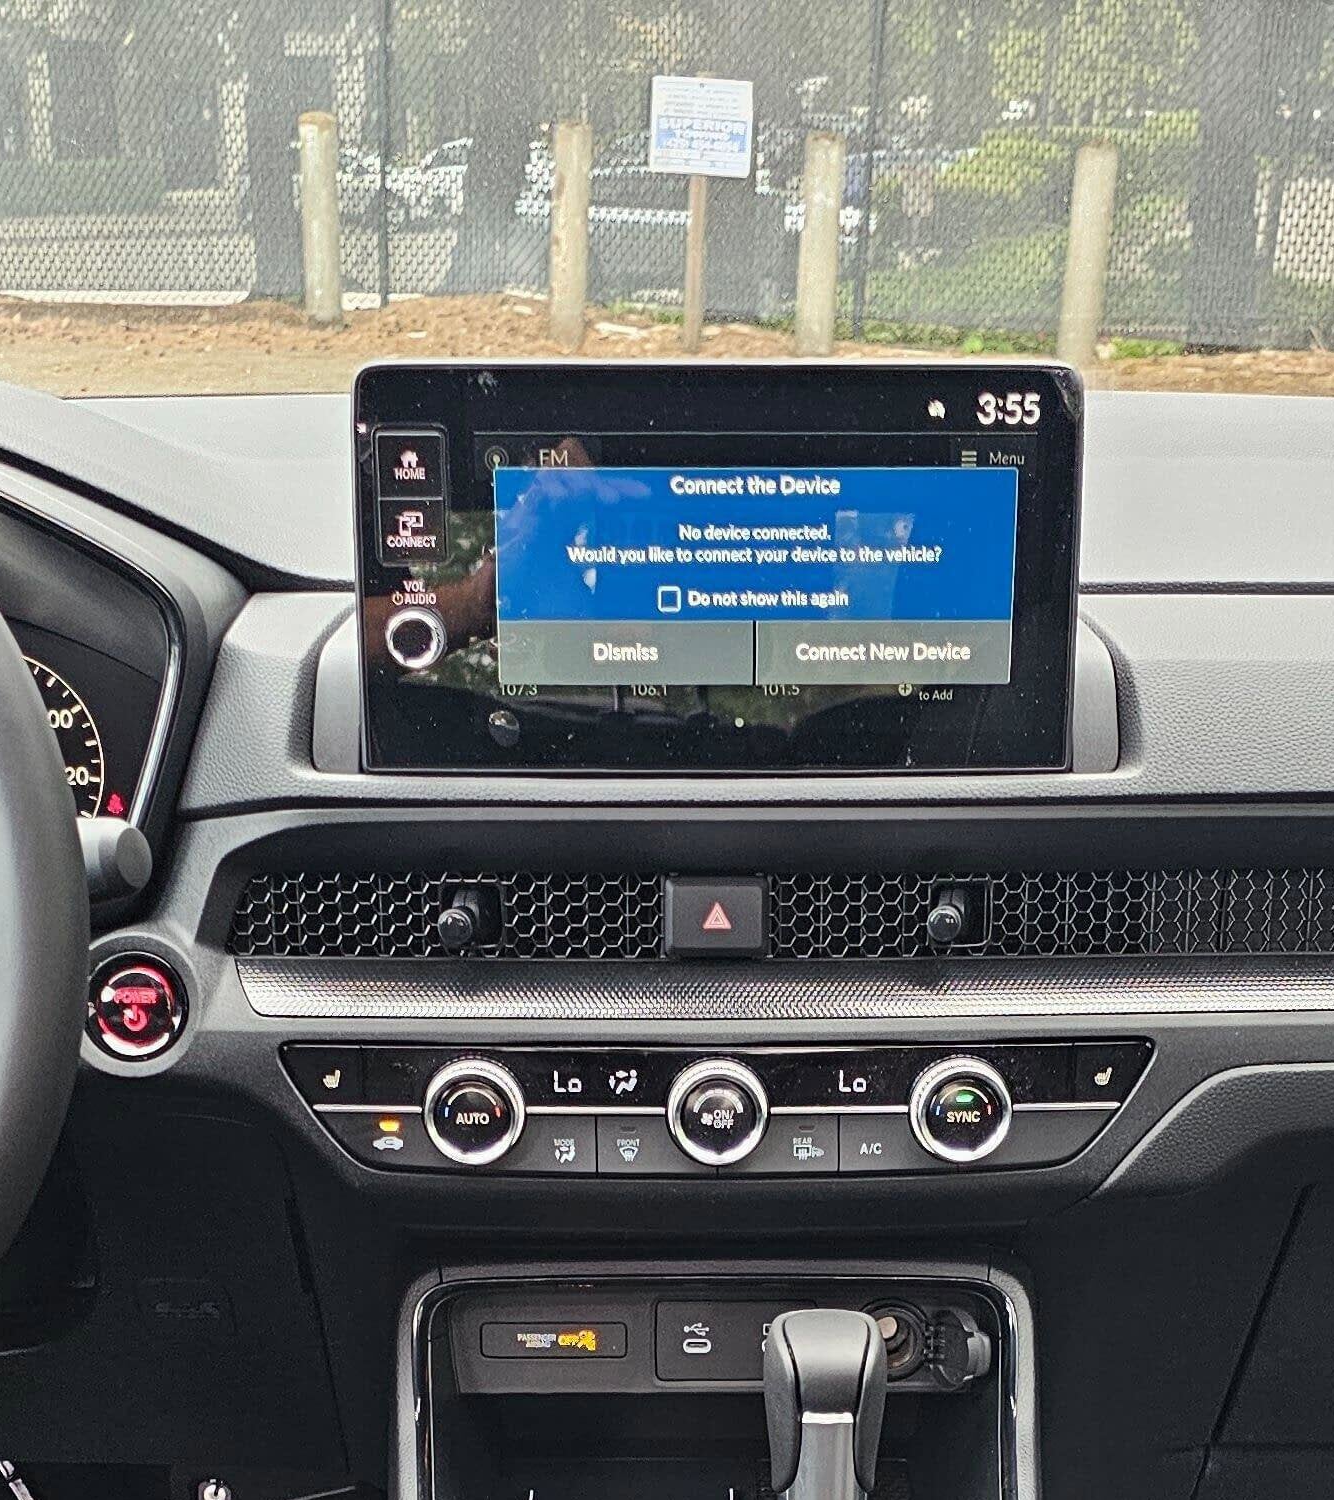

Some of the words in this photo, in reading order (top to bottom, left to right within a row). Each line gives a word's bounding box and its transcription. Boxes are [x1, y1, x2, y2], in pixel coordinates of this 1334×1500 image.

[976, 392, 1041, 426] 3:55
[539, 450, 568, 466] FM
[989, 452, 1025, 466] Menu
[394, 467, 426, 480] HOME
[670, 476, 744, 495] Connect
[748, 476, 776, 495] the
[780, 476, 841, 495] Device
[679, 524, 701, 541] No
[704, 523, 750, 541] device
[753, 523, 831, 541] connected.
[386, 535, 437, 548] CONNECT
[567, 546, 614, 563] Would
[616, 550, 646, 566] you
[648, 546, 673, 563] like
[675, 548, 692, 563] to
[695, 547, 752, 563] connect
[754, 550, 788, 566] your
[791, 546, 836, 563] device
[840, 548, 856, 563] to
[858, 546, 882, 563] the
[885, 546, 942, 563] vehicle?
[403, 580, 425, 592] VOL
[405, 592, 437, 605] AUDIO
[688, 591, 709, 607] Do
[712, 592, 737, 607] not
[740, 591, 778, 607] show
[781, 591, 807, 607] this
[810, 591, 849, 611] again
[593, 642, 659, 661] Dismiss
[796, 642, 867, 662] Connect
[869, 642, 910, 662] New
[913, 642, 971, 662] Device
[919, 691, 929, 701] to
[932, 689, 954, 701] Add
[113, 987, 158, 1004] POWER
[553, 1070, 582, 1093] Lo
[838, 1070, 867, 1093] Lo
[456, 1113, 490, 1126] AUTO
[713, 1119, 734, 1129] OFF
[946, 1111, 981, 1124] SYNC
[553, 1139, 575, 1148] MODE
[616, 1139, 640, 1148] FRONT
[793, 1138, 813, 1146] REAR
[860, 1143, 882, 1156] A/C
